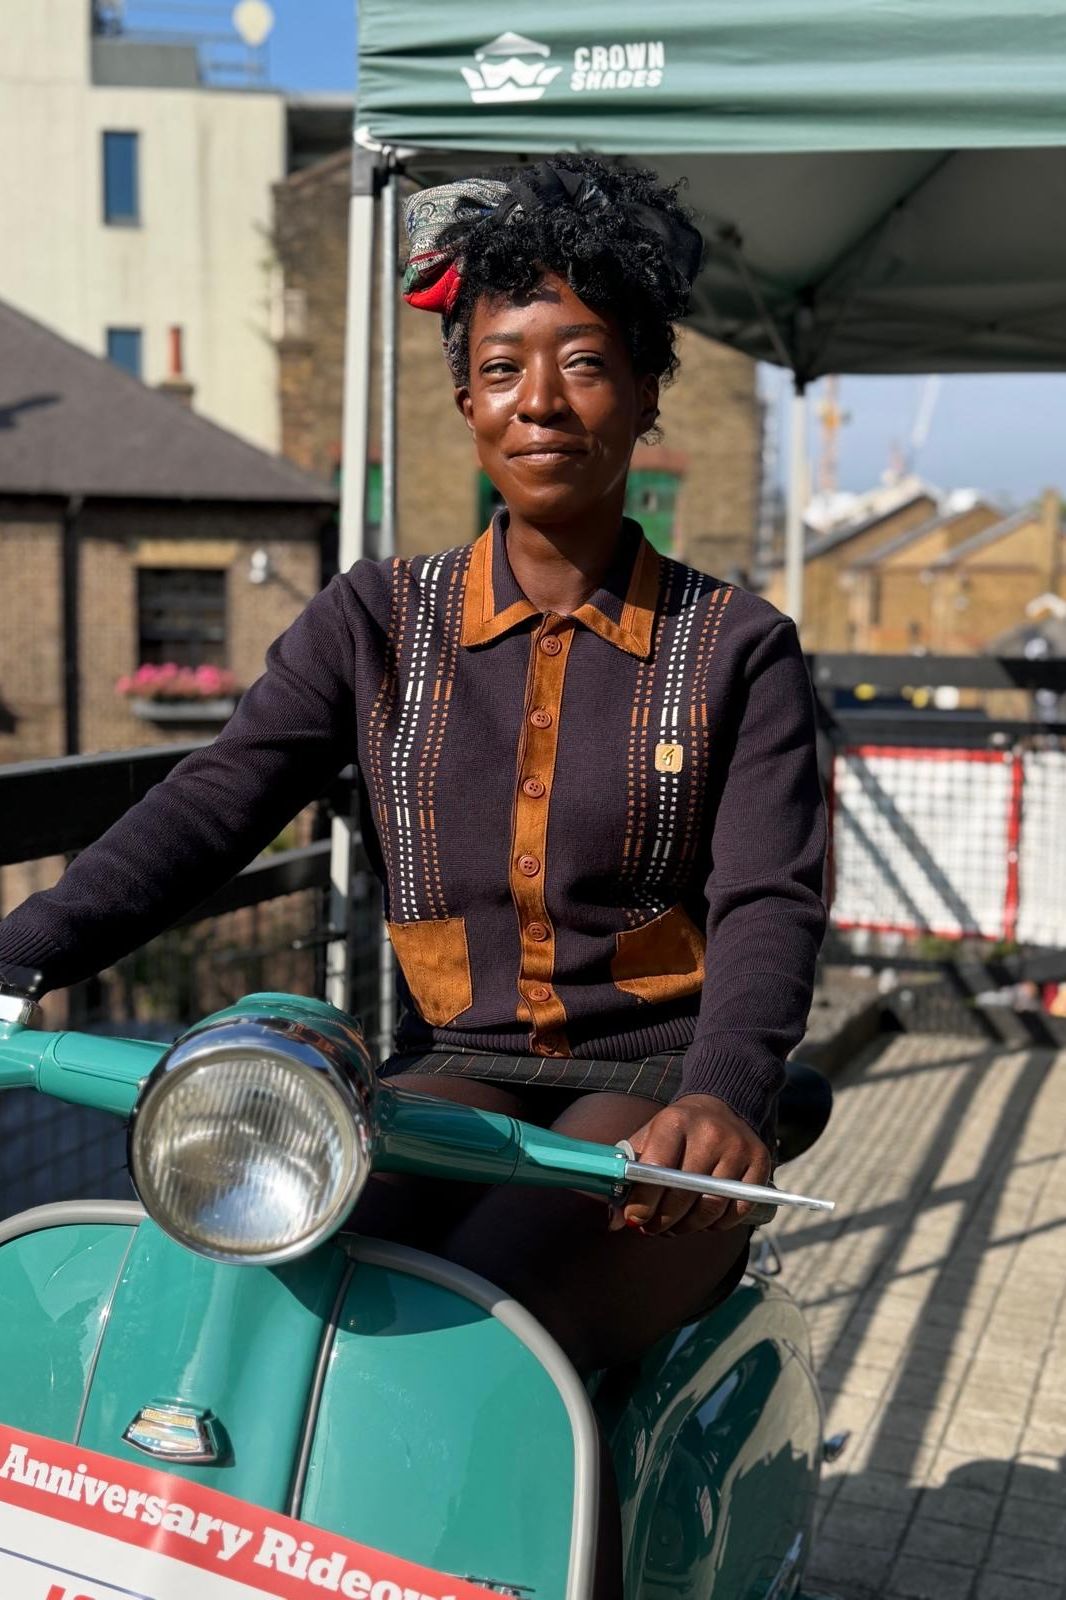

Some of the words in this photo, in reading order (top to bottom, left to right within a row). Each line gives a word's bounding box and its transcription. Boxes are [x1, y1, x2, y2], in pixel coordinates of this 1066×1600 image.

[574, 41, 665, 71] CROWN
[570, 69, 663, 91] SHADES
[0, 1443, 253, 1561] Anniversary
[253, 1526, 456, 1600] Rideo
